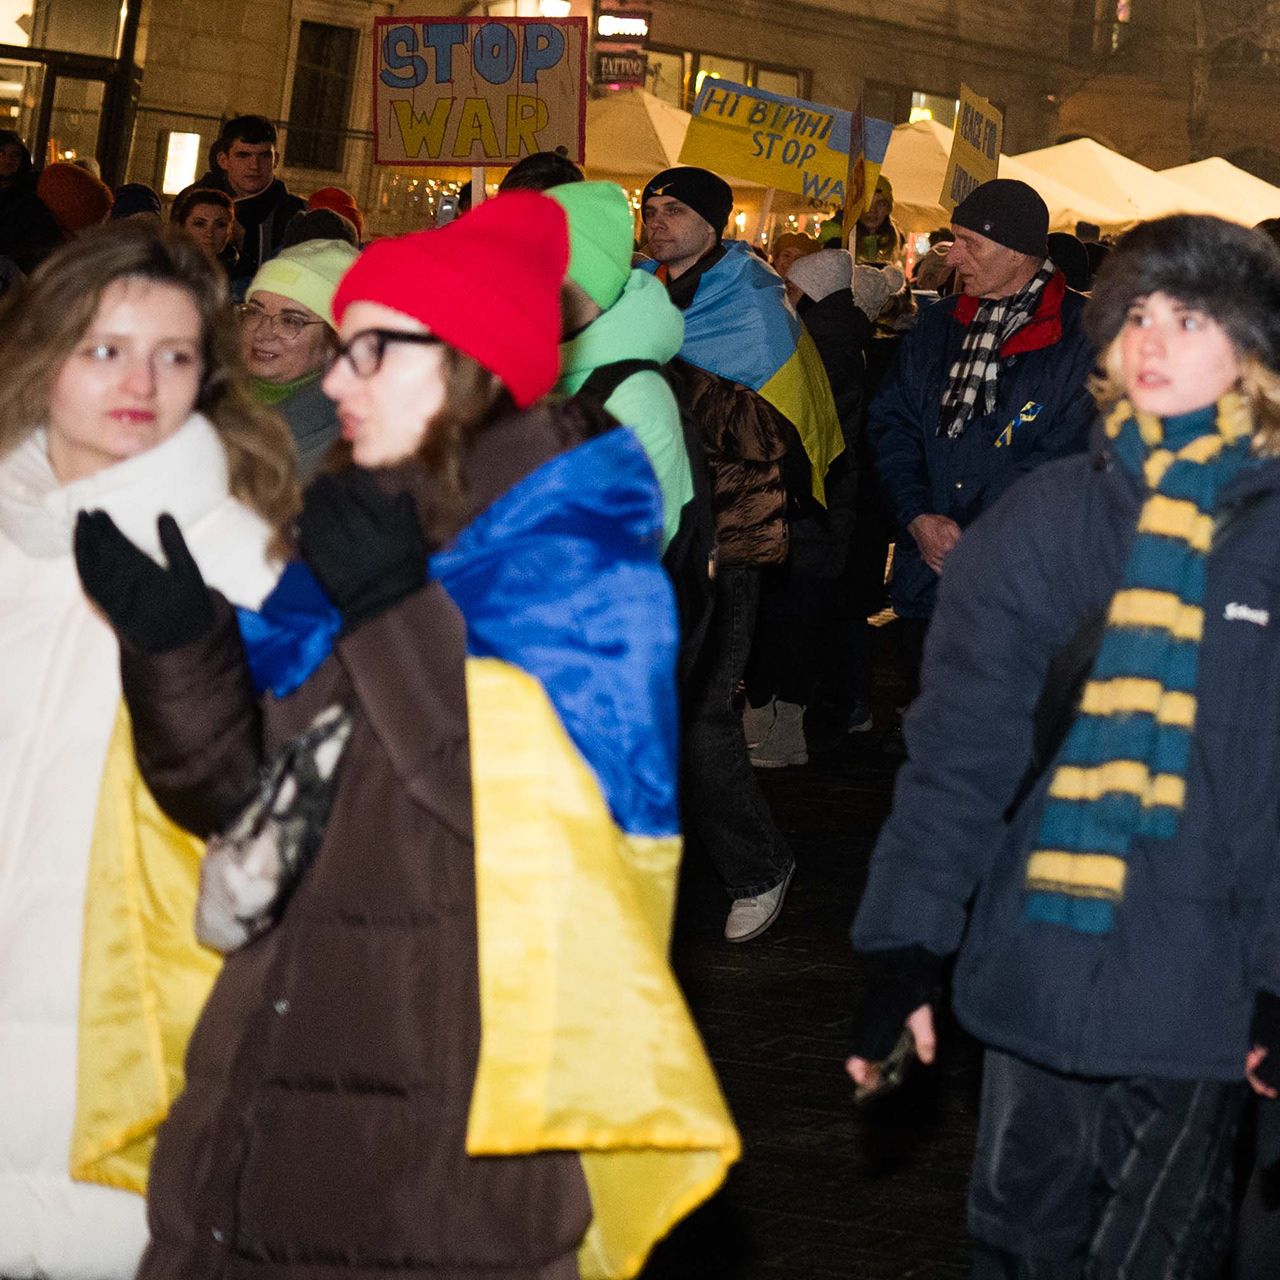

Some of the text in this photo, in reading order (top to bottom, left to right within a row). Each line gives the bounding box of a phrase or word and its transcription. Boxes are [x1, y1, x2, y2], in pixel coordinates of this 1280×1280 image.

[379, 23, 565, 89] STOP
[392, 95, 549, 158] WAR
[751, 131, 817, 168] STOP
[803, 171, 846, 206] WA
